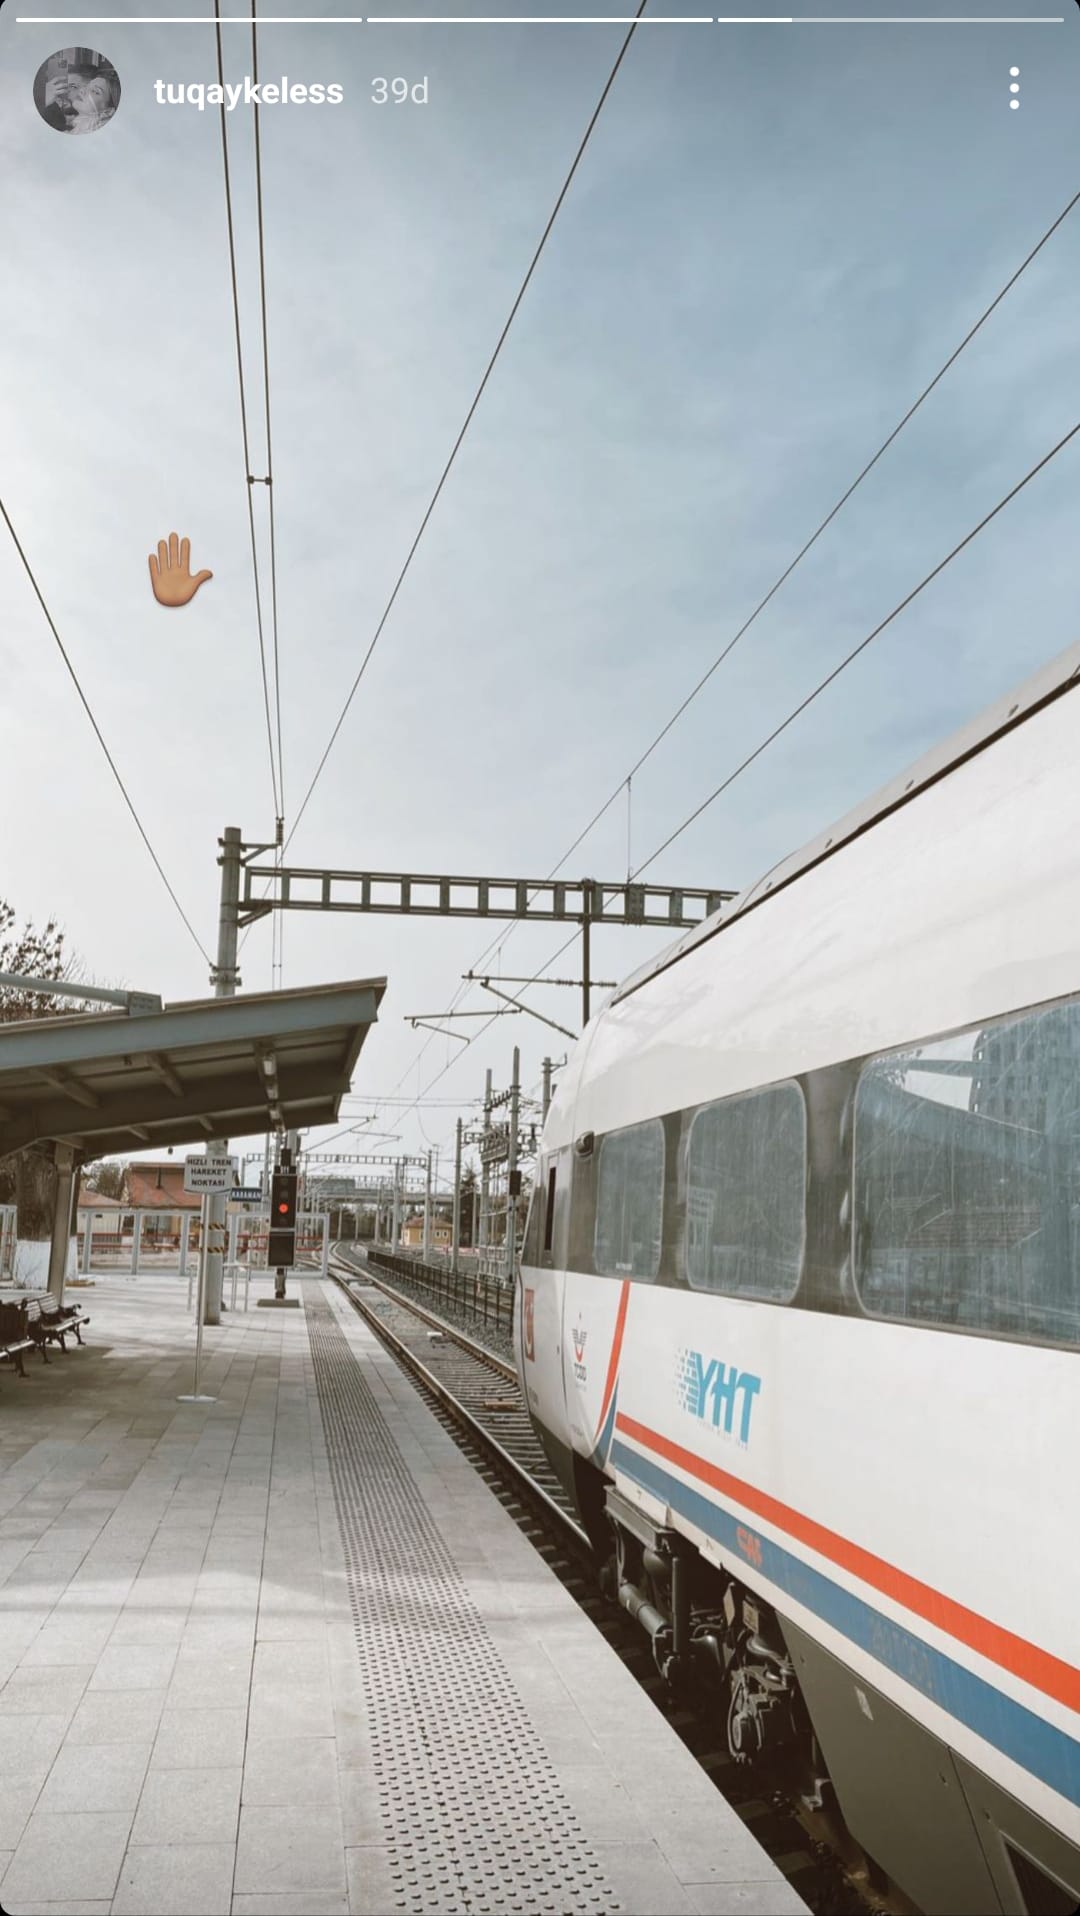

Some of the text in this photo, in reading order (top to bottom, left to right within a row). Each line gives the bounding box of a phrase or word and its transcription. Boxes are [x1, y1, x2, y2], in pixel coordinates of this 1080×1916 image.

[187, 1158, 232, 1166] HIZLI TREN
[191, 1168, 227, 1176] HAREKET
[191, 1179, 225, 1187] NOKTASI
[684, 1350, 762, 1444] YHT
